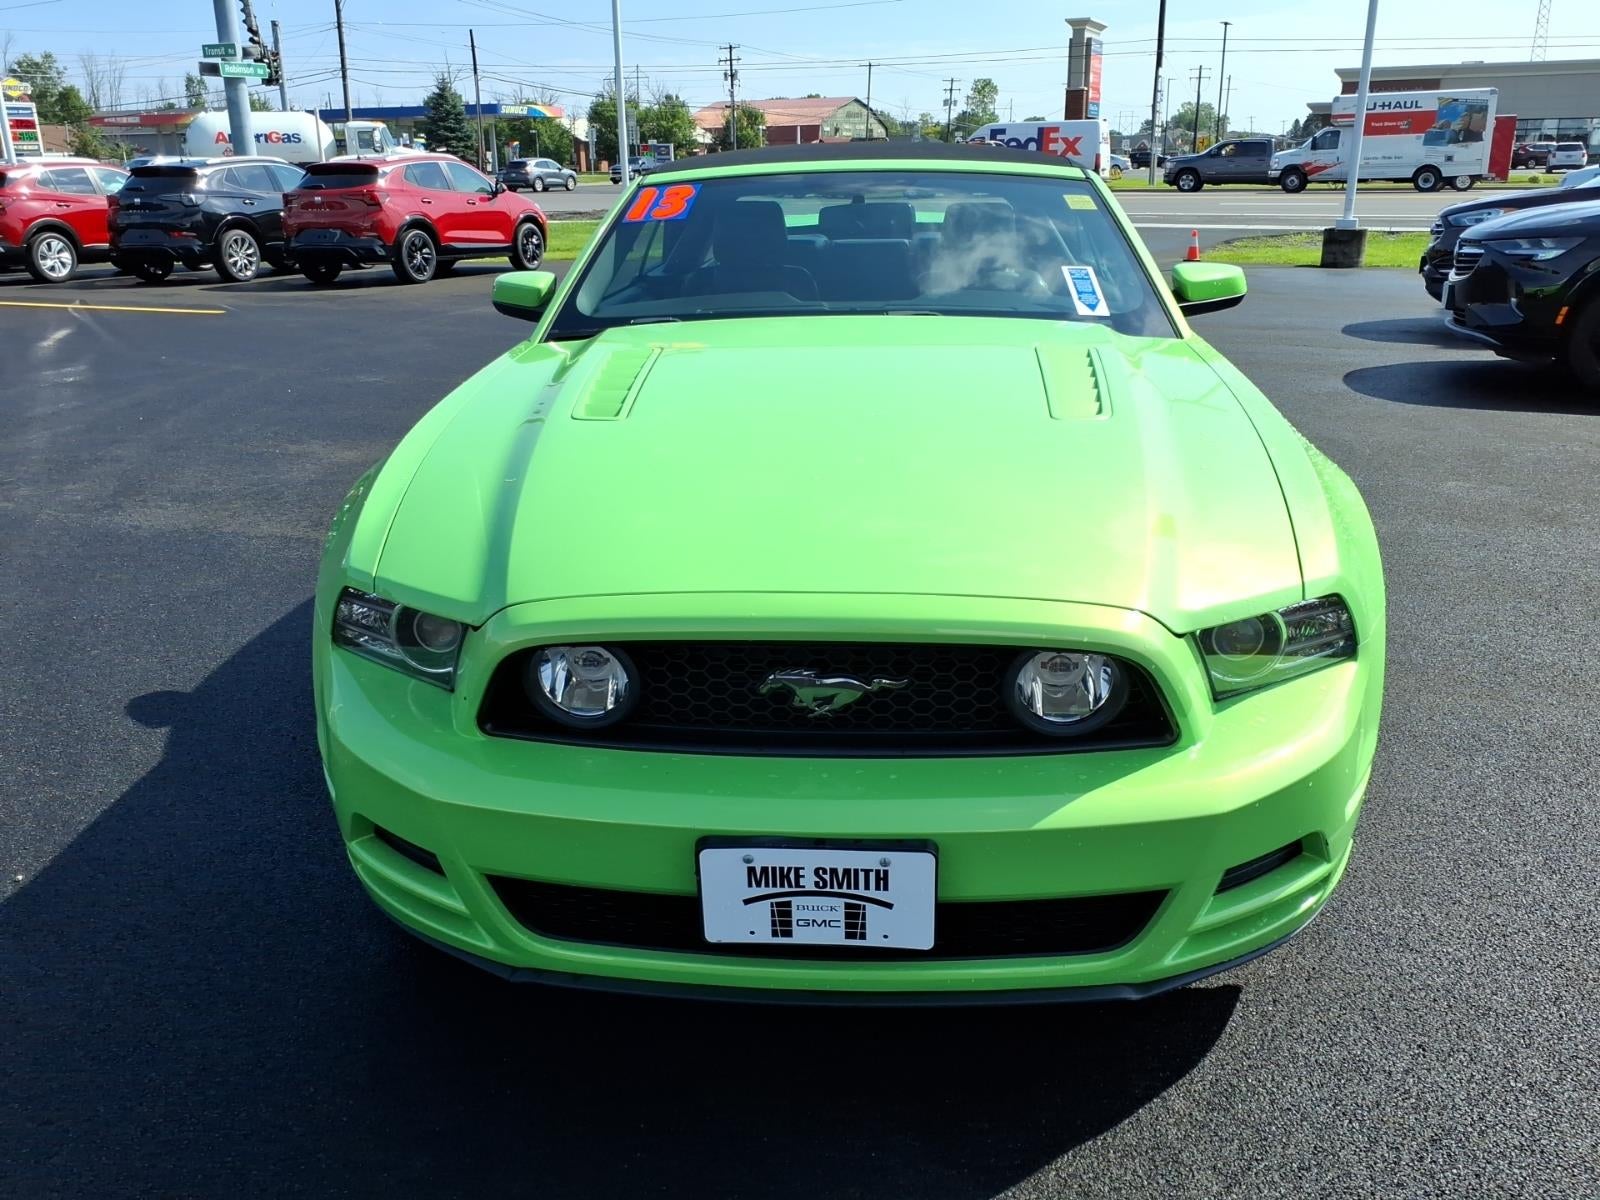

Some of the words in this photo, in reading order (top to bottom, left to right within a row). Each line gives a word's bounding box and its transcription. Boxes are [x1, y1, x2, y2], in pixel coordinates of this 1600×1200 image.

[204, 47, 225, 55] Transit
[224, 64, 254, 74] Robinson
[500, 105, 527, 114] SUNOCO
[1366, 100, 1423, 111] U-HAUL
[625, 184, 696, 222] 13
[747, 866, 806, 889] MIKE
[813, 867, 890, 892] SMITH
[796, 904, 839, 912] BUICK
[796, 918, 841, 928] GMC
